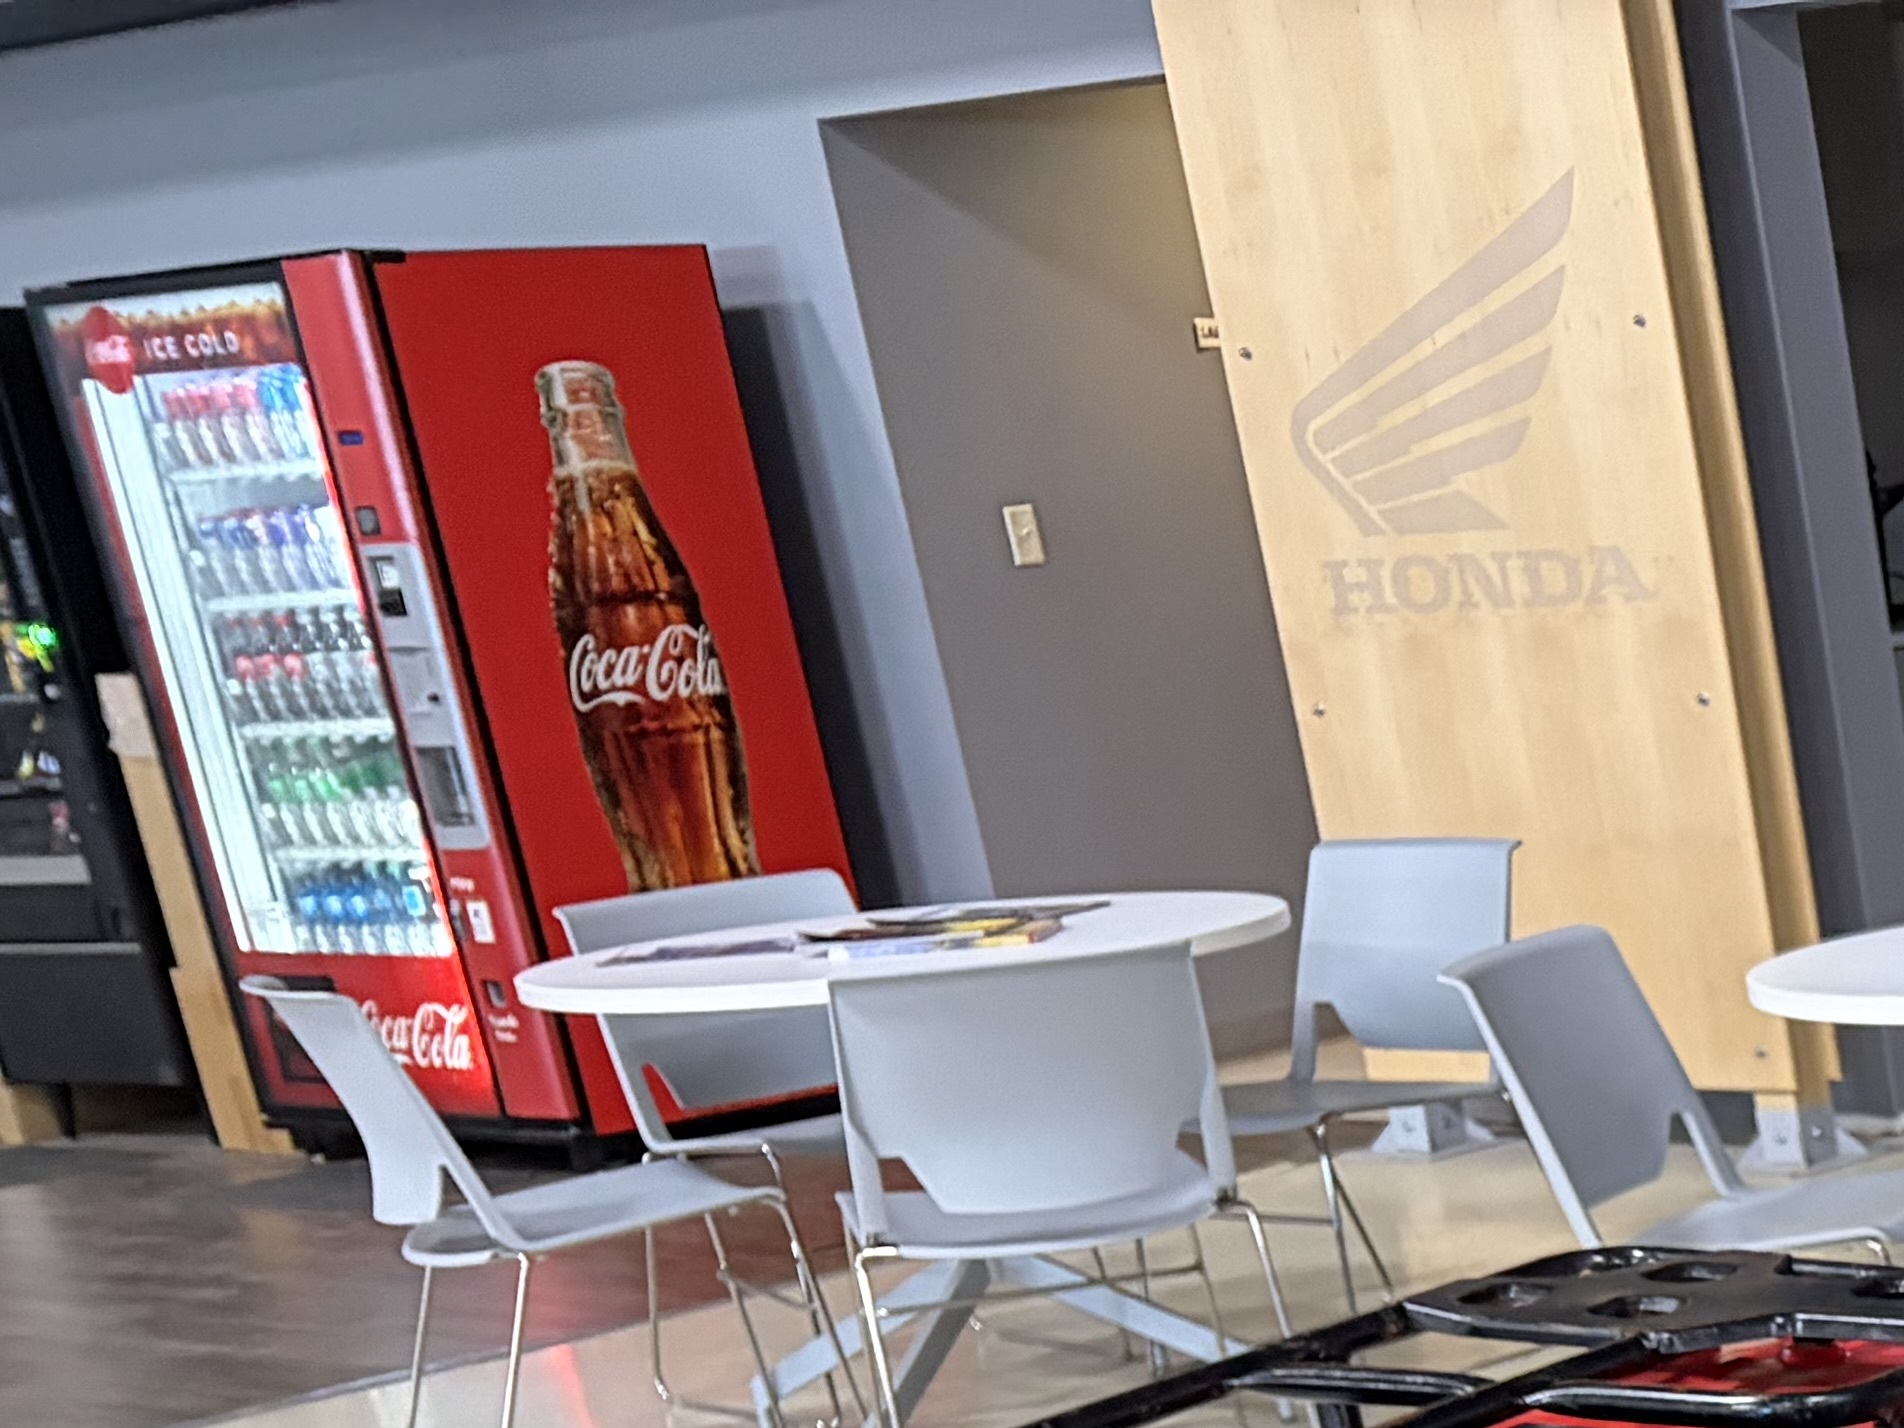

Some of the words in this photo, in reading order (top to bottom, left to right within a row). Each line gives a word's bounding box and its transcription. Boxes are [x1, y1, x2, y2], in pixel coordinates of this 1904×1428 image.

[143, 336, 181, 360] ICE
[183, 330, 241, 357] COLD
[1322, 544, 1662, 618] HONDA
[569, 623, 726, 713] Coca-Cola
